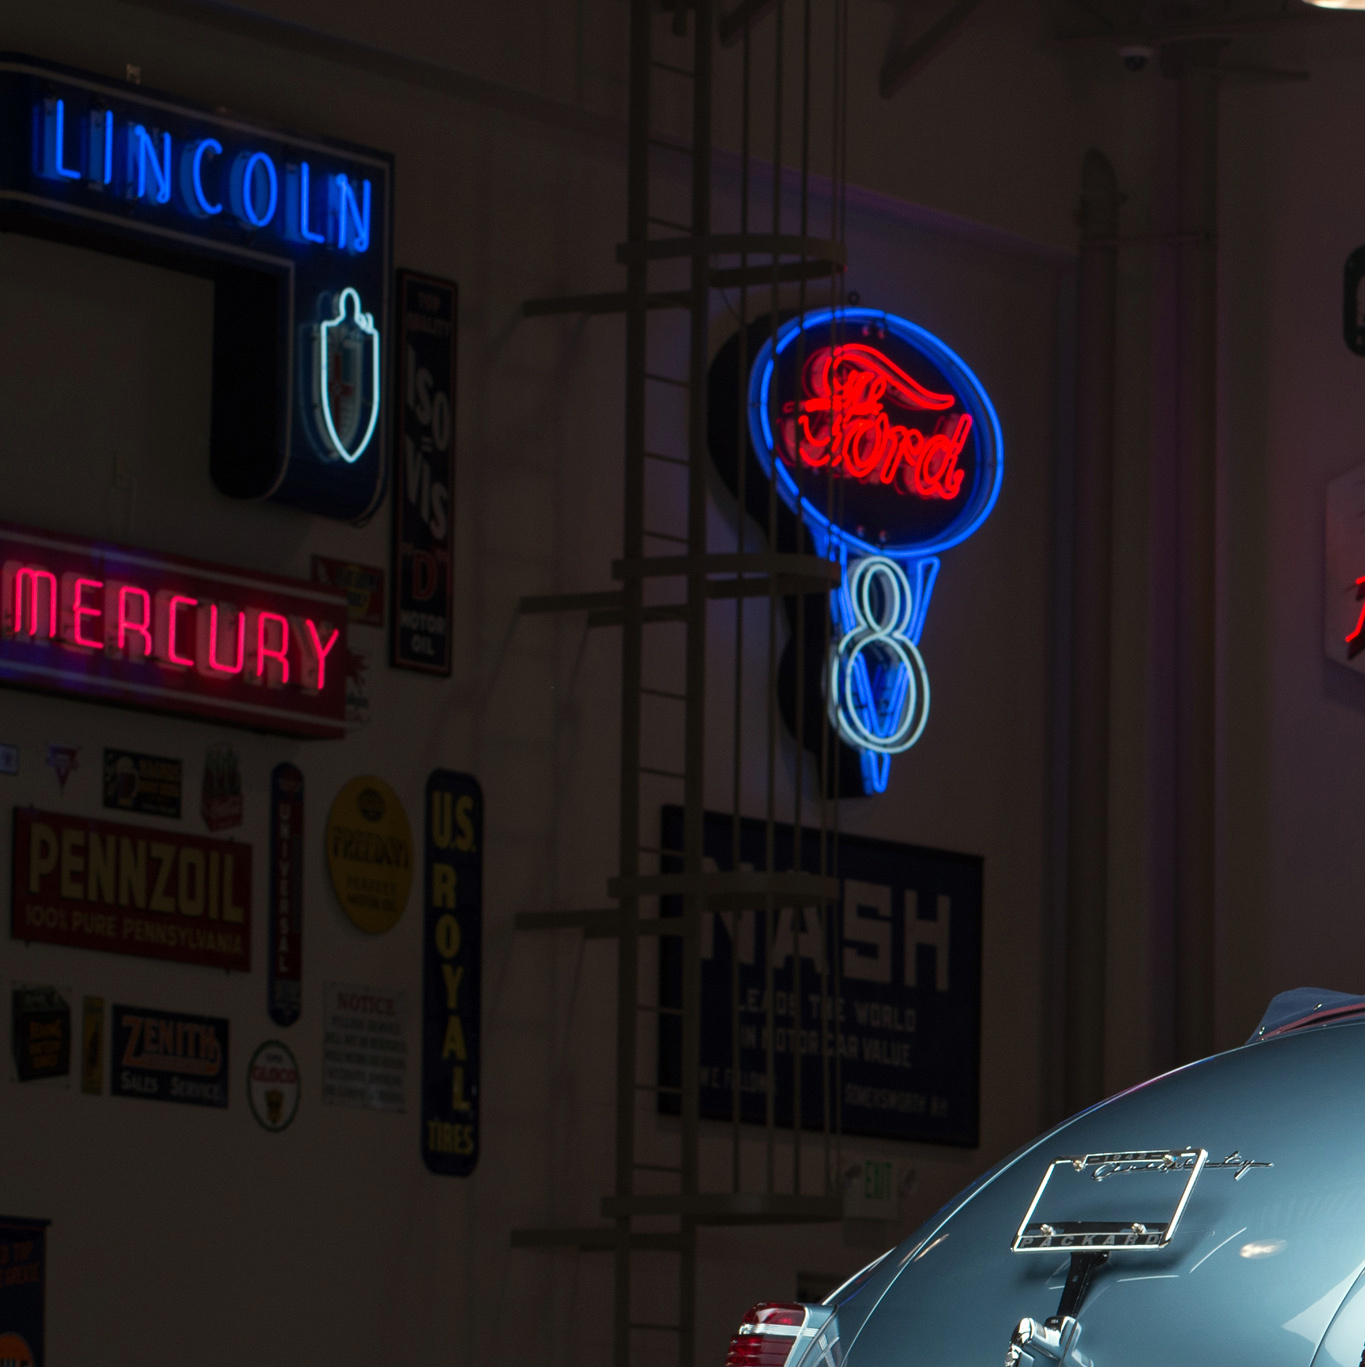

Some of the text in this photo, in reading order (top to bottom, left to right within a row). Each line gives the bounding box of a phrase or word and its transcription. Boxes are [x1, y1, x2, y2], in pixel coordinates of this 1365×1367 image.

[40, 97, 373, 254] LINCOLN
[799, 342, 972, 498] Ford
[8, 564, 340, 692] MERCURY
[402, 609, 447, 635] MOTOR
[411, 633, 436, 657] OIL
[430, 790, 477, 854] U.S.
[27, 821, 246, 925] PENNZOIL
[277, 803, 293, 975] UNIVERSAL
[25, 903, 243, 956] 100% PURE PENNSYLVANIA
[701, 855, 951, 994] NASH
[337, 992, 397, 1017] NOTICE
[432, 861, 472, 1112] ROYAL
[739, 987, 797, 1018] EDS
[854, 1000, 917, 1033] WORLD
[121, 1014, 221, 1074] ZENITH
[862, 1038, 912, 1069] VALUE
[120, 1069, 221, 1100] SALES SERVICE
[426, 1118, 475, 1157] TIRES
[865, 1160, 893, 1199] EXIT
[1020, 1233, 1160, 1248] PACKARD
